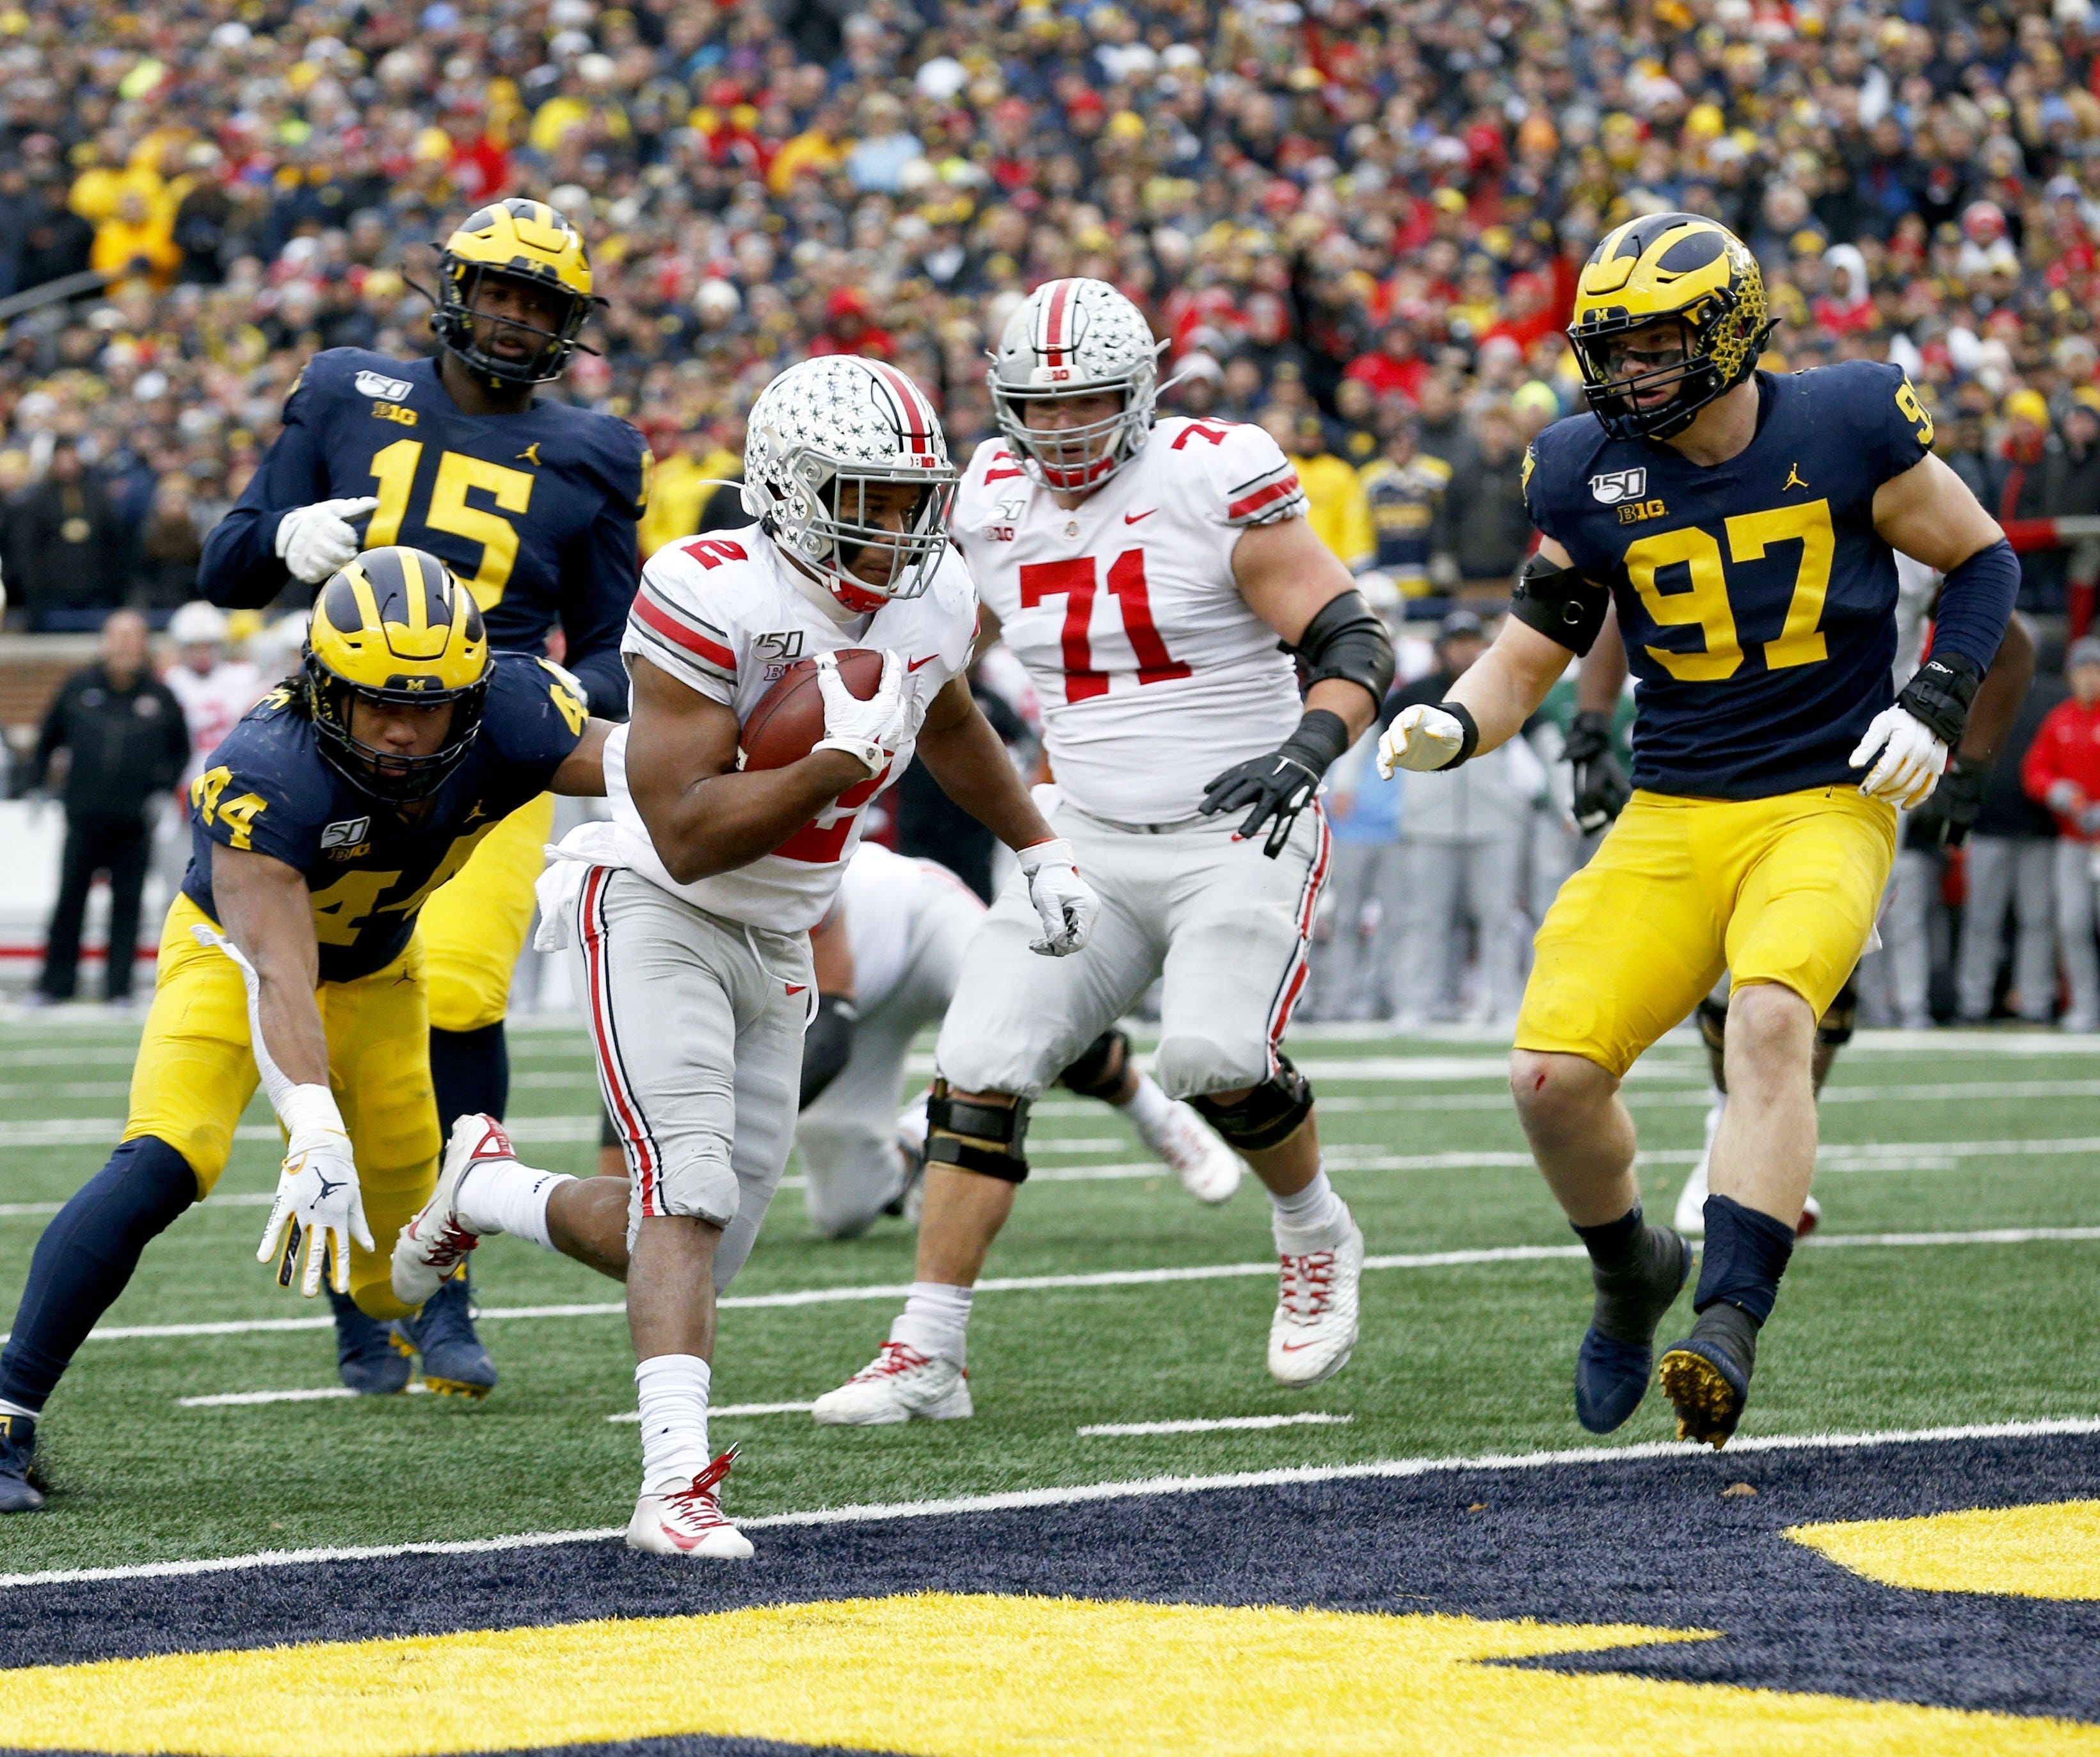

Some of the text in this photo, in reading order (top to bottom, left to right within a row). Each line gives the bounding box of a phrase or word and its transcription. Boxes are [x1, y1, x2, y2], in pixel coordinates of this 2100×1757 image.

[1594, 308, 1609, 322] M
[355, 369, 415, 402] 150
[1588, 467, 1647, 504] 150
[364, 439, 534, 613] 15
[680, 540, 748, 570] 2
[1623, 498, 1836, 682] 97
[1020, 548, 1192, 703] 71
[753, 630, 805, 661] 150
[406, 679, 426, 691] M
[191, 766, 268, 850] 44
